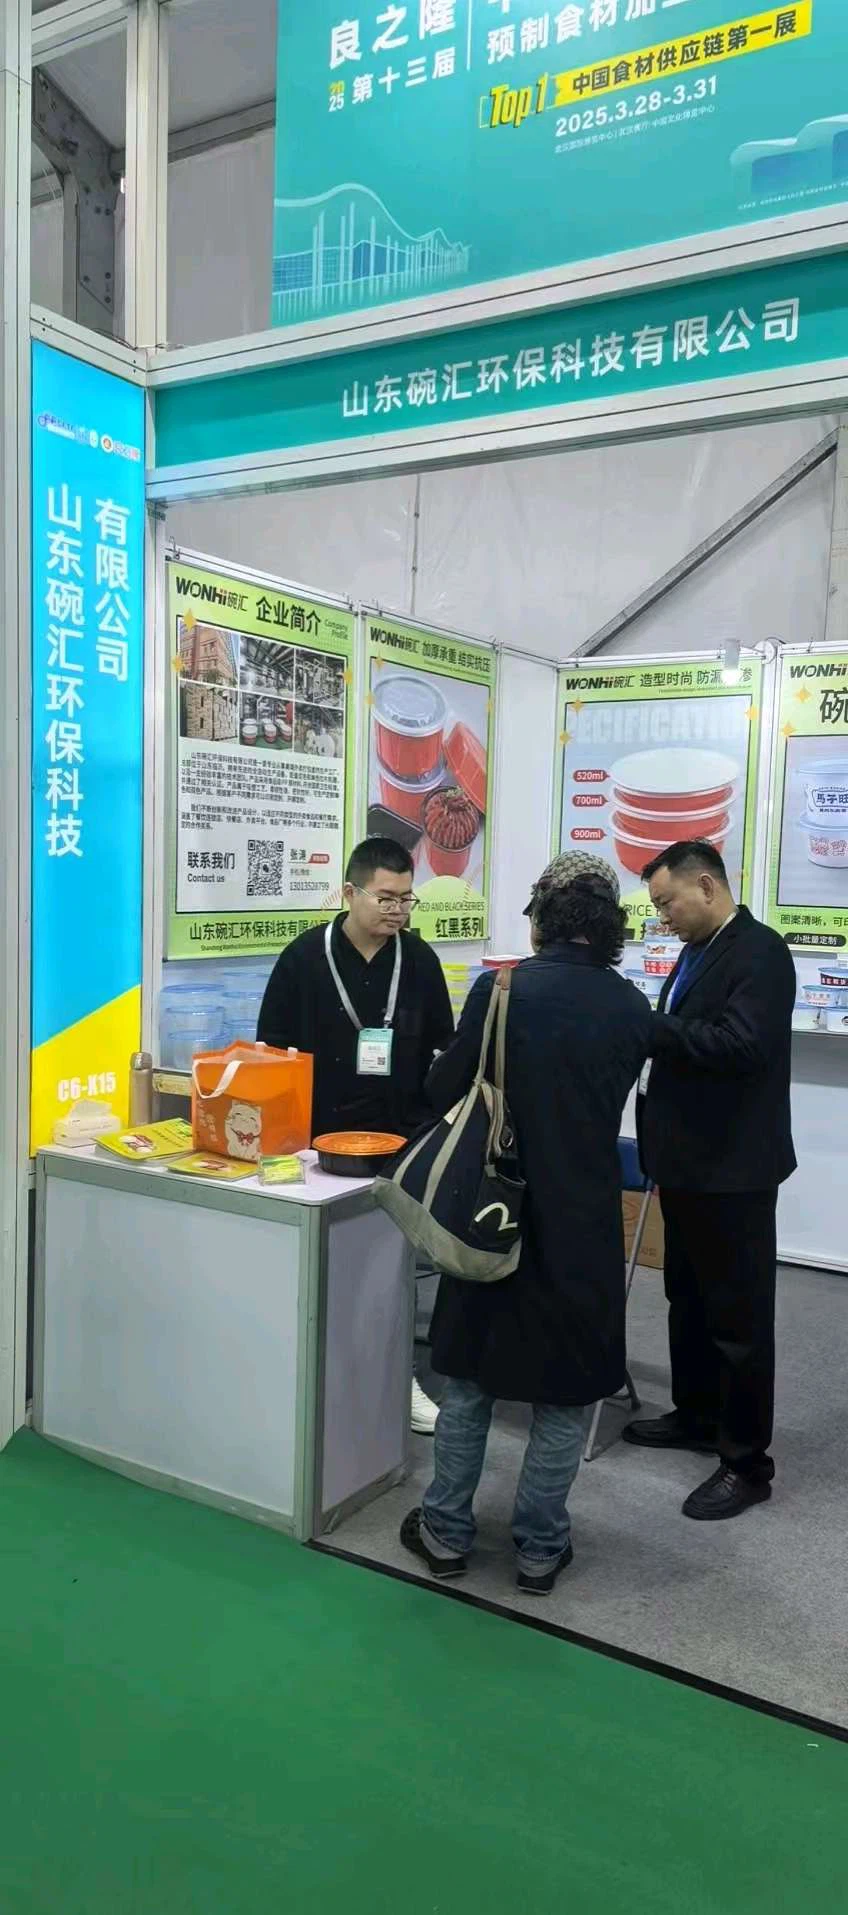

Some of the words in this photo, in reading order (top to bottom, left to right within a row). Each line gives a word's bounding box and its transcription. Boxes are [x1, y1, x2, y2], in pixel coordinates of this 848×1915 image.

[486, 0, 690, 64] 预制食材加
[572, 9, 797, 96] 中国食材供应链第一展
[352, 47, 456, 105] 第十三届
[555, 75, 718, 138] 2025.3.28-3.31
[342, 297, 801, 419] 山东碗汇环保科技有限公司
[94, 498, 132, 682] 有限公司
[255, 595, 321, 637] 企业简介
[45, 483, 85, 858] 山东碗汇环保科技
[640, 671, 693, 688] 造型时尚
[576, 771, 604, 781] 520ml
[575, 796, 603, 806] 700ml
[573, 829, 601, 839] 900ml
[187, 851, 236, 869] 联系我们
[187, 872, 215, 883] Contact
[216, 874, 225, 883] us
[435, 916, 484, 938] 红黑系列
[793, 934, 837, 946] 小批量定制
